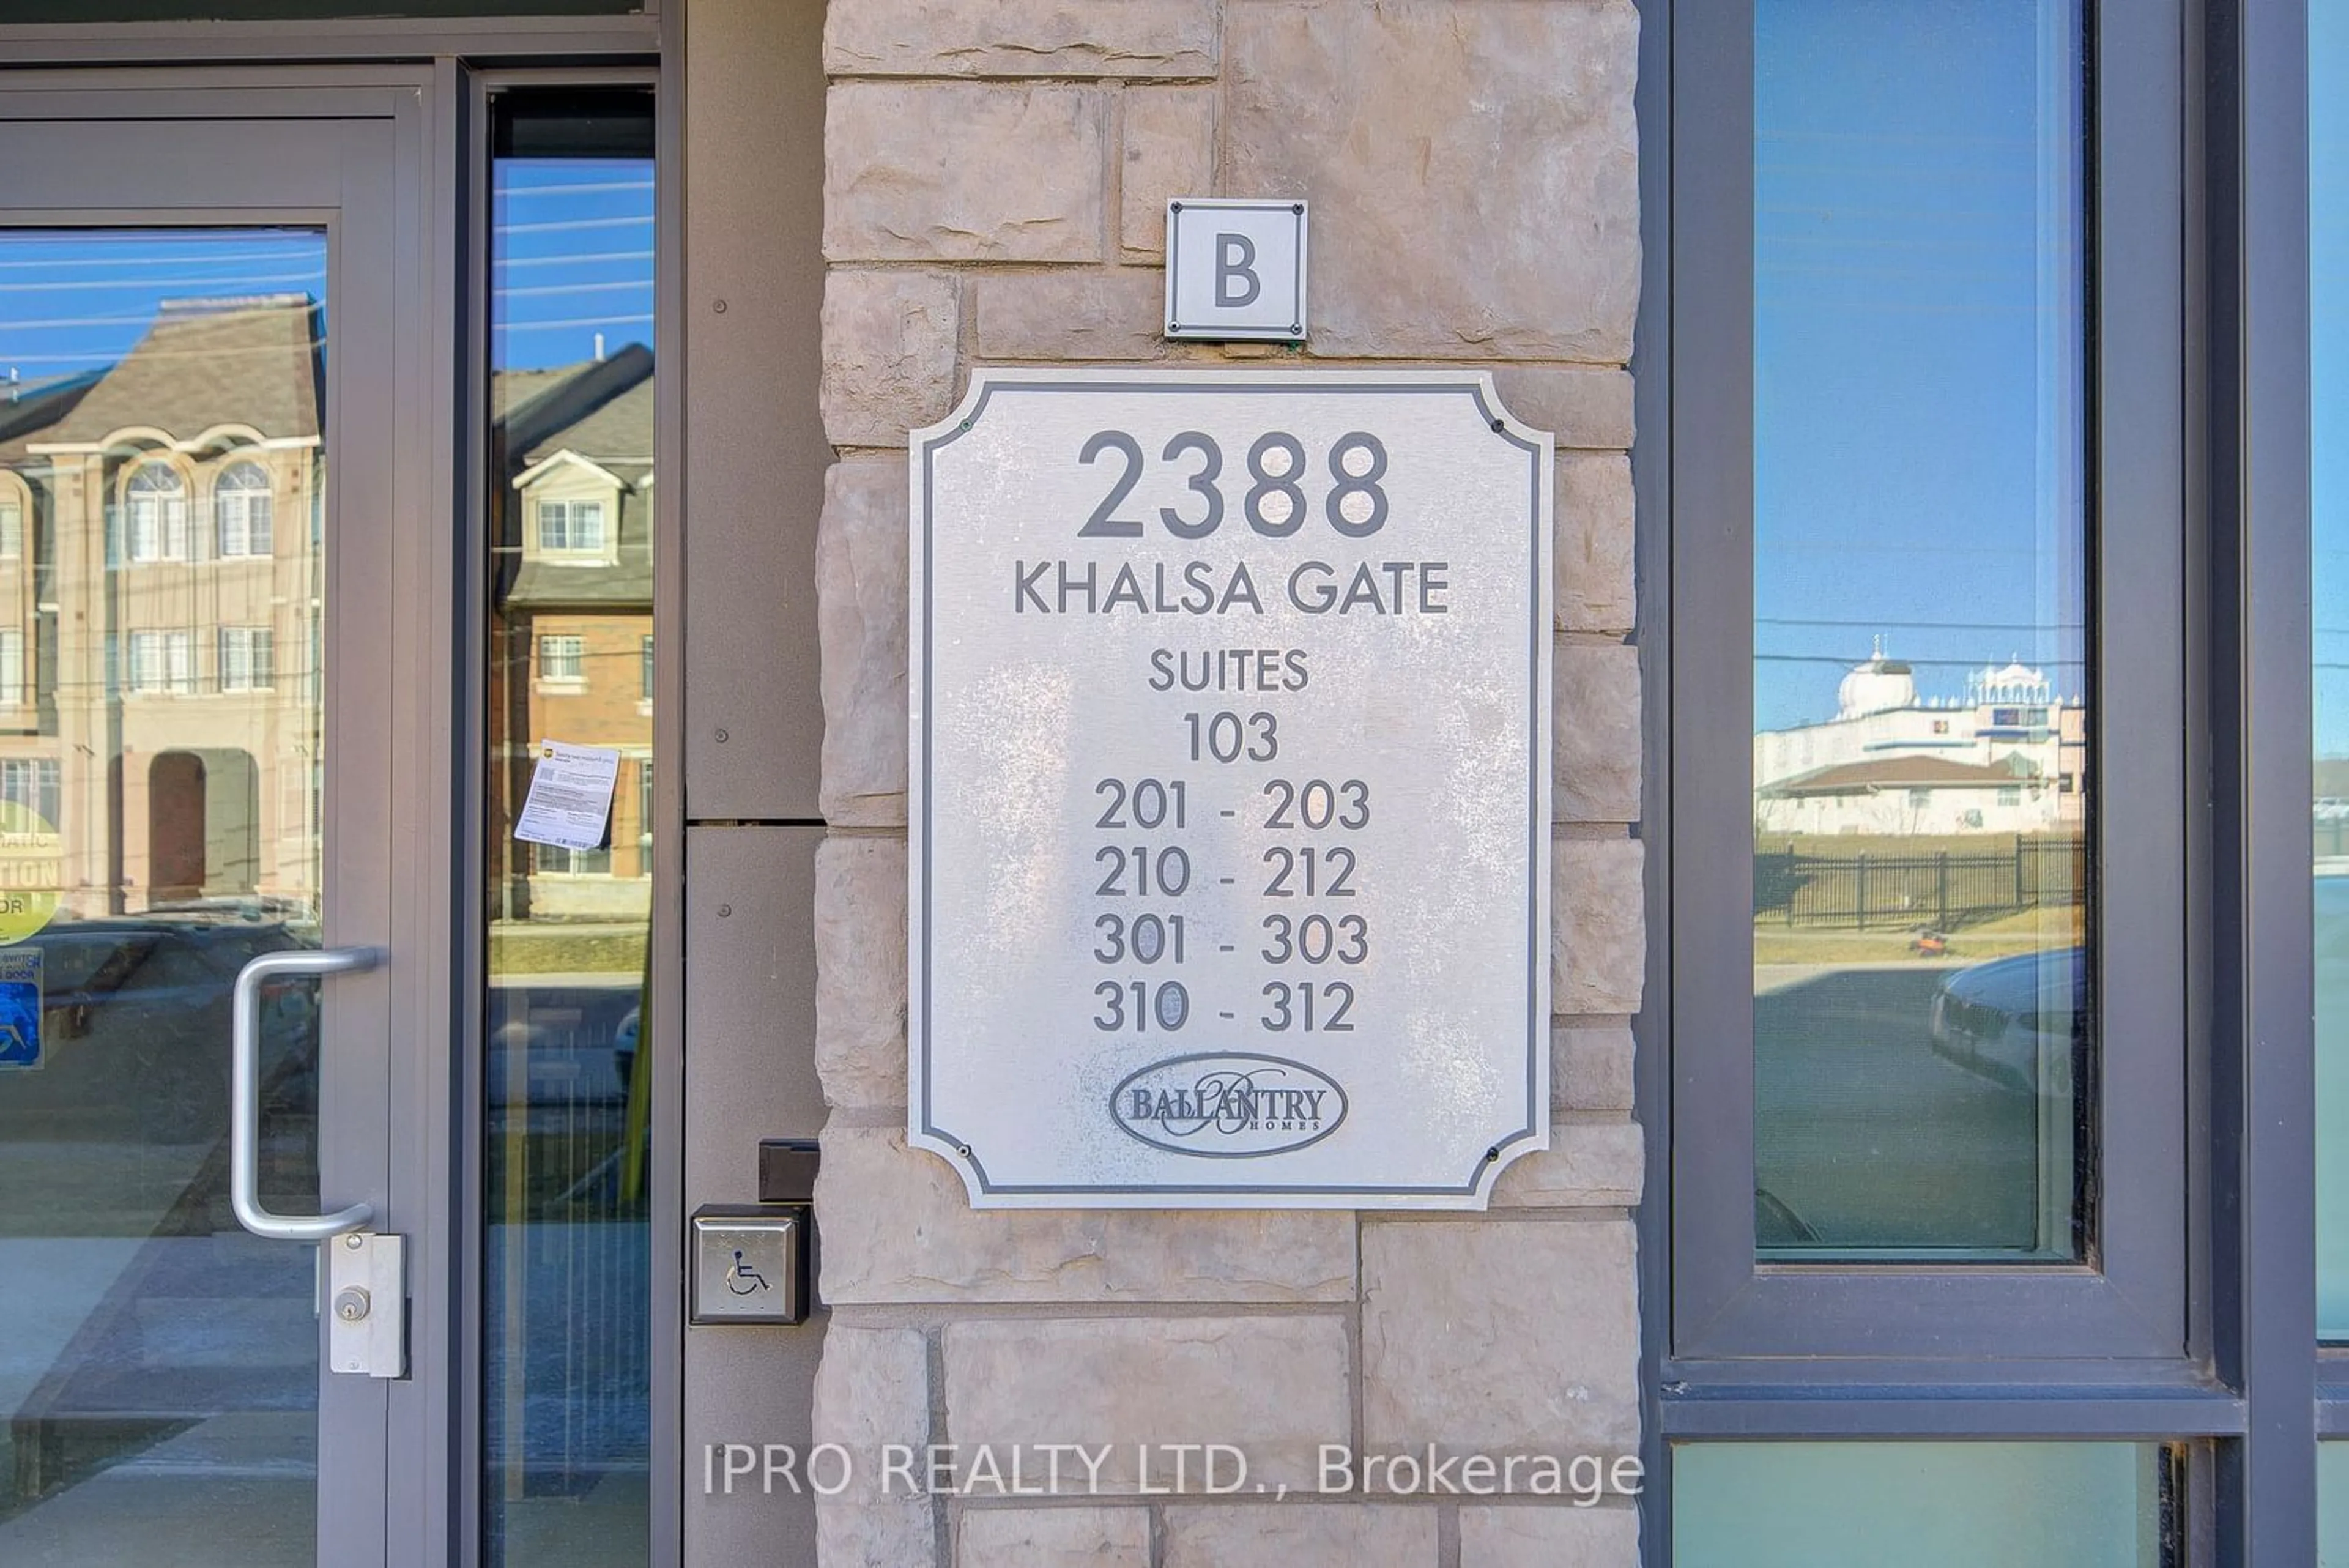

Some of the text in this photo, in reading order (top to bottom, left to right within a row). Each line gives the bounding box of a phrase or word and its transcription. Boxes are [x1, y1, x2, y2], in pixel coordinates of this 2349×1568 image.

[1215, 234, 1260, 307] B
[1078, 431, 1389, 540] 2388
[1016, 561, 1448, 614] KHALSA GATE
[1149, 649, 1308, 691] SUITES
[1184, 712, 1278, 763] 103
[1095, 779, 1186, 829] 201
[1264, 779, 1370, 830] 203
[0, 861, 58, 888] TION
[1095, 845, 1191, 897] 210
[1263, 847, 1356, 897] 212
[0, 899, 23, 914] OR
[1094, 913, 1184, 964] 301
[1261, 914, 1368, 964] 303
[1093, 981, 1189, 1031] 310
[1261, 981, 1354, 1032] 312
[1129, 1090, 1327, 1120] BALLANTRY
[1250, 1121, 1321, 1131] HOMES
